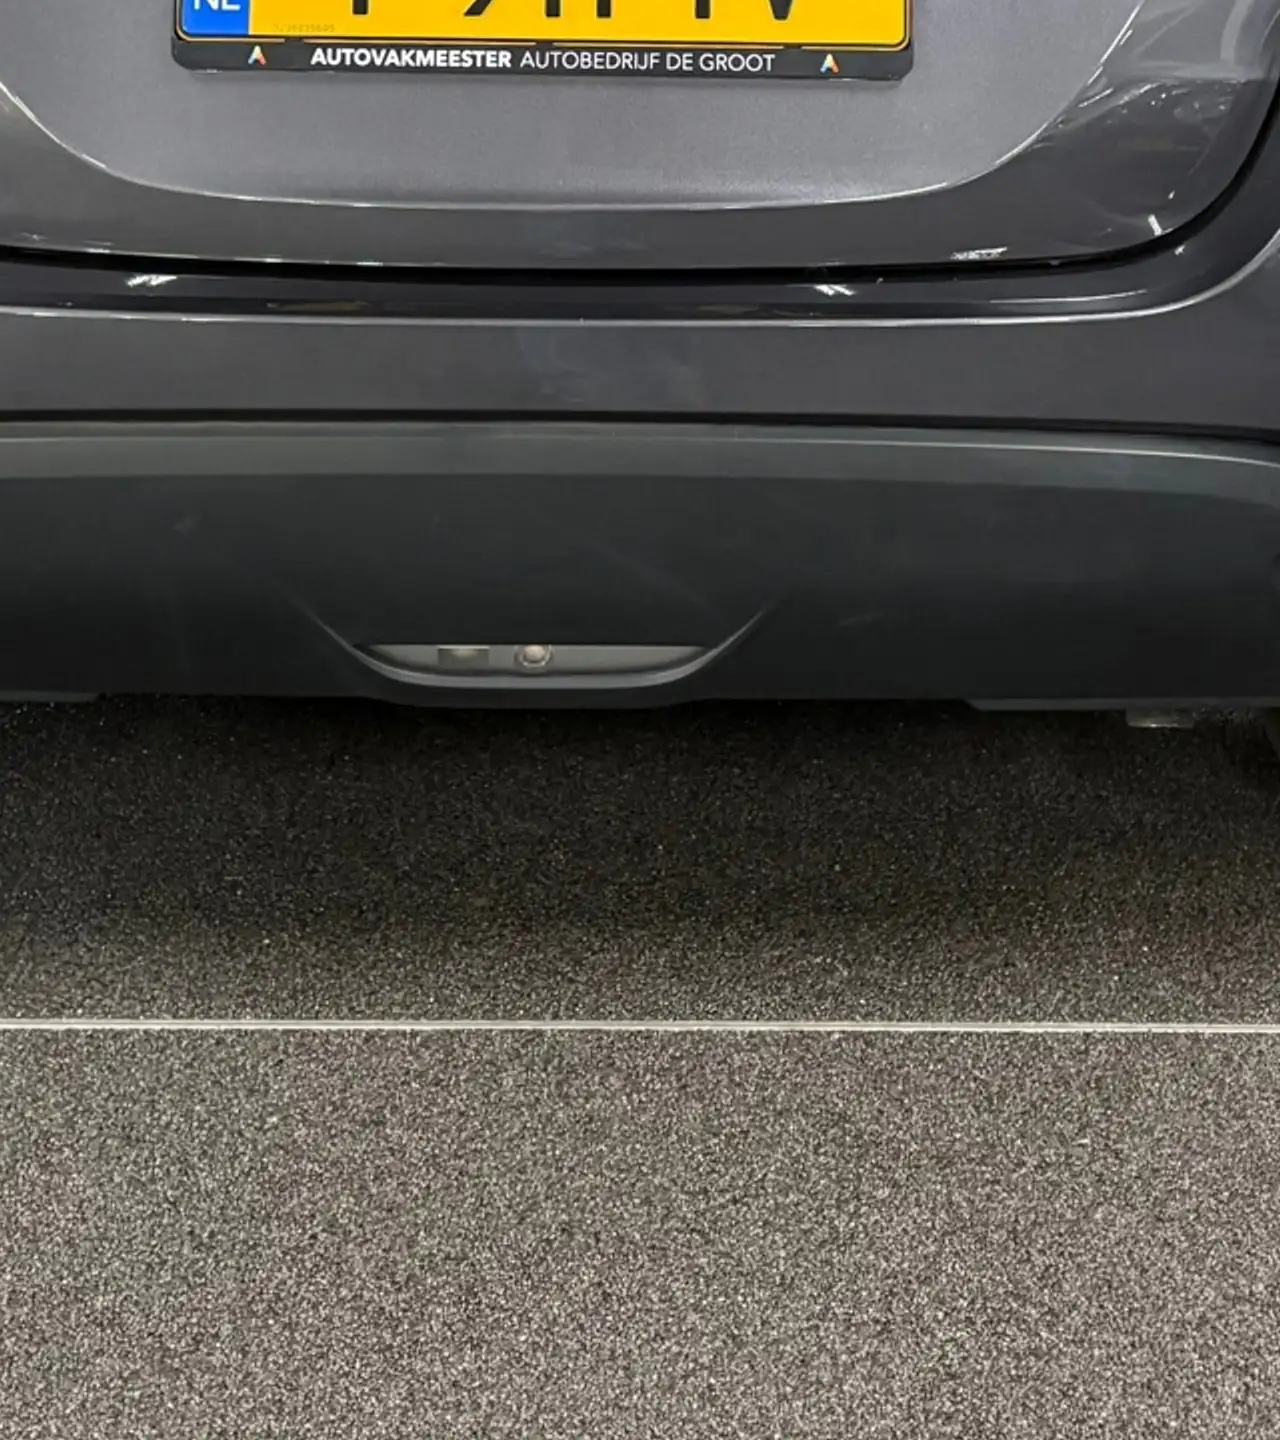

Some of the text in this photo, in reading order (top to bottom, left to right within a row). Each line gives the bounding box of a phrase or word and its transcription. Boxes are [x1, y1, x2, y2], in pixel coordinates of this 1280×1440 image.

[310, 47, 776, 73] AUTOVAKMEESTER AUTOBEDRIJF DE GROOT
